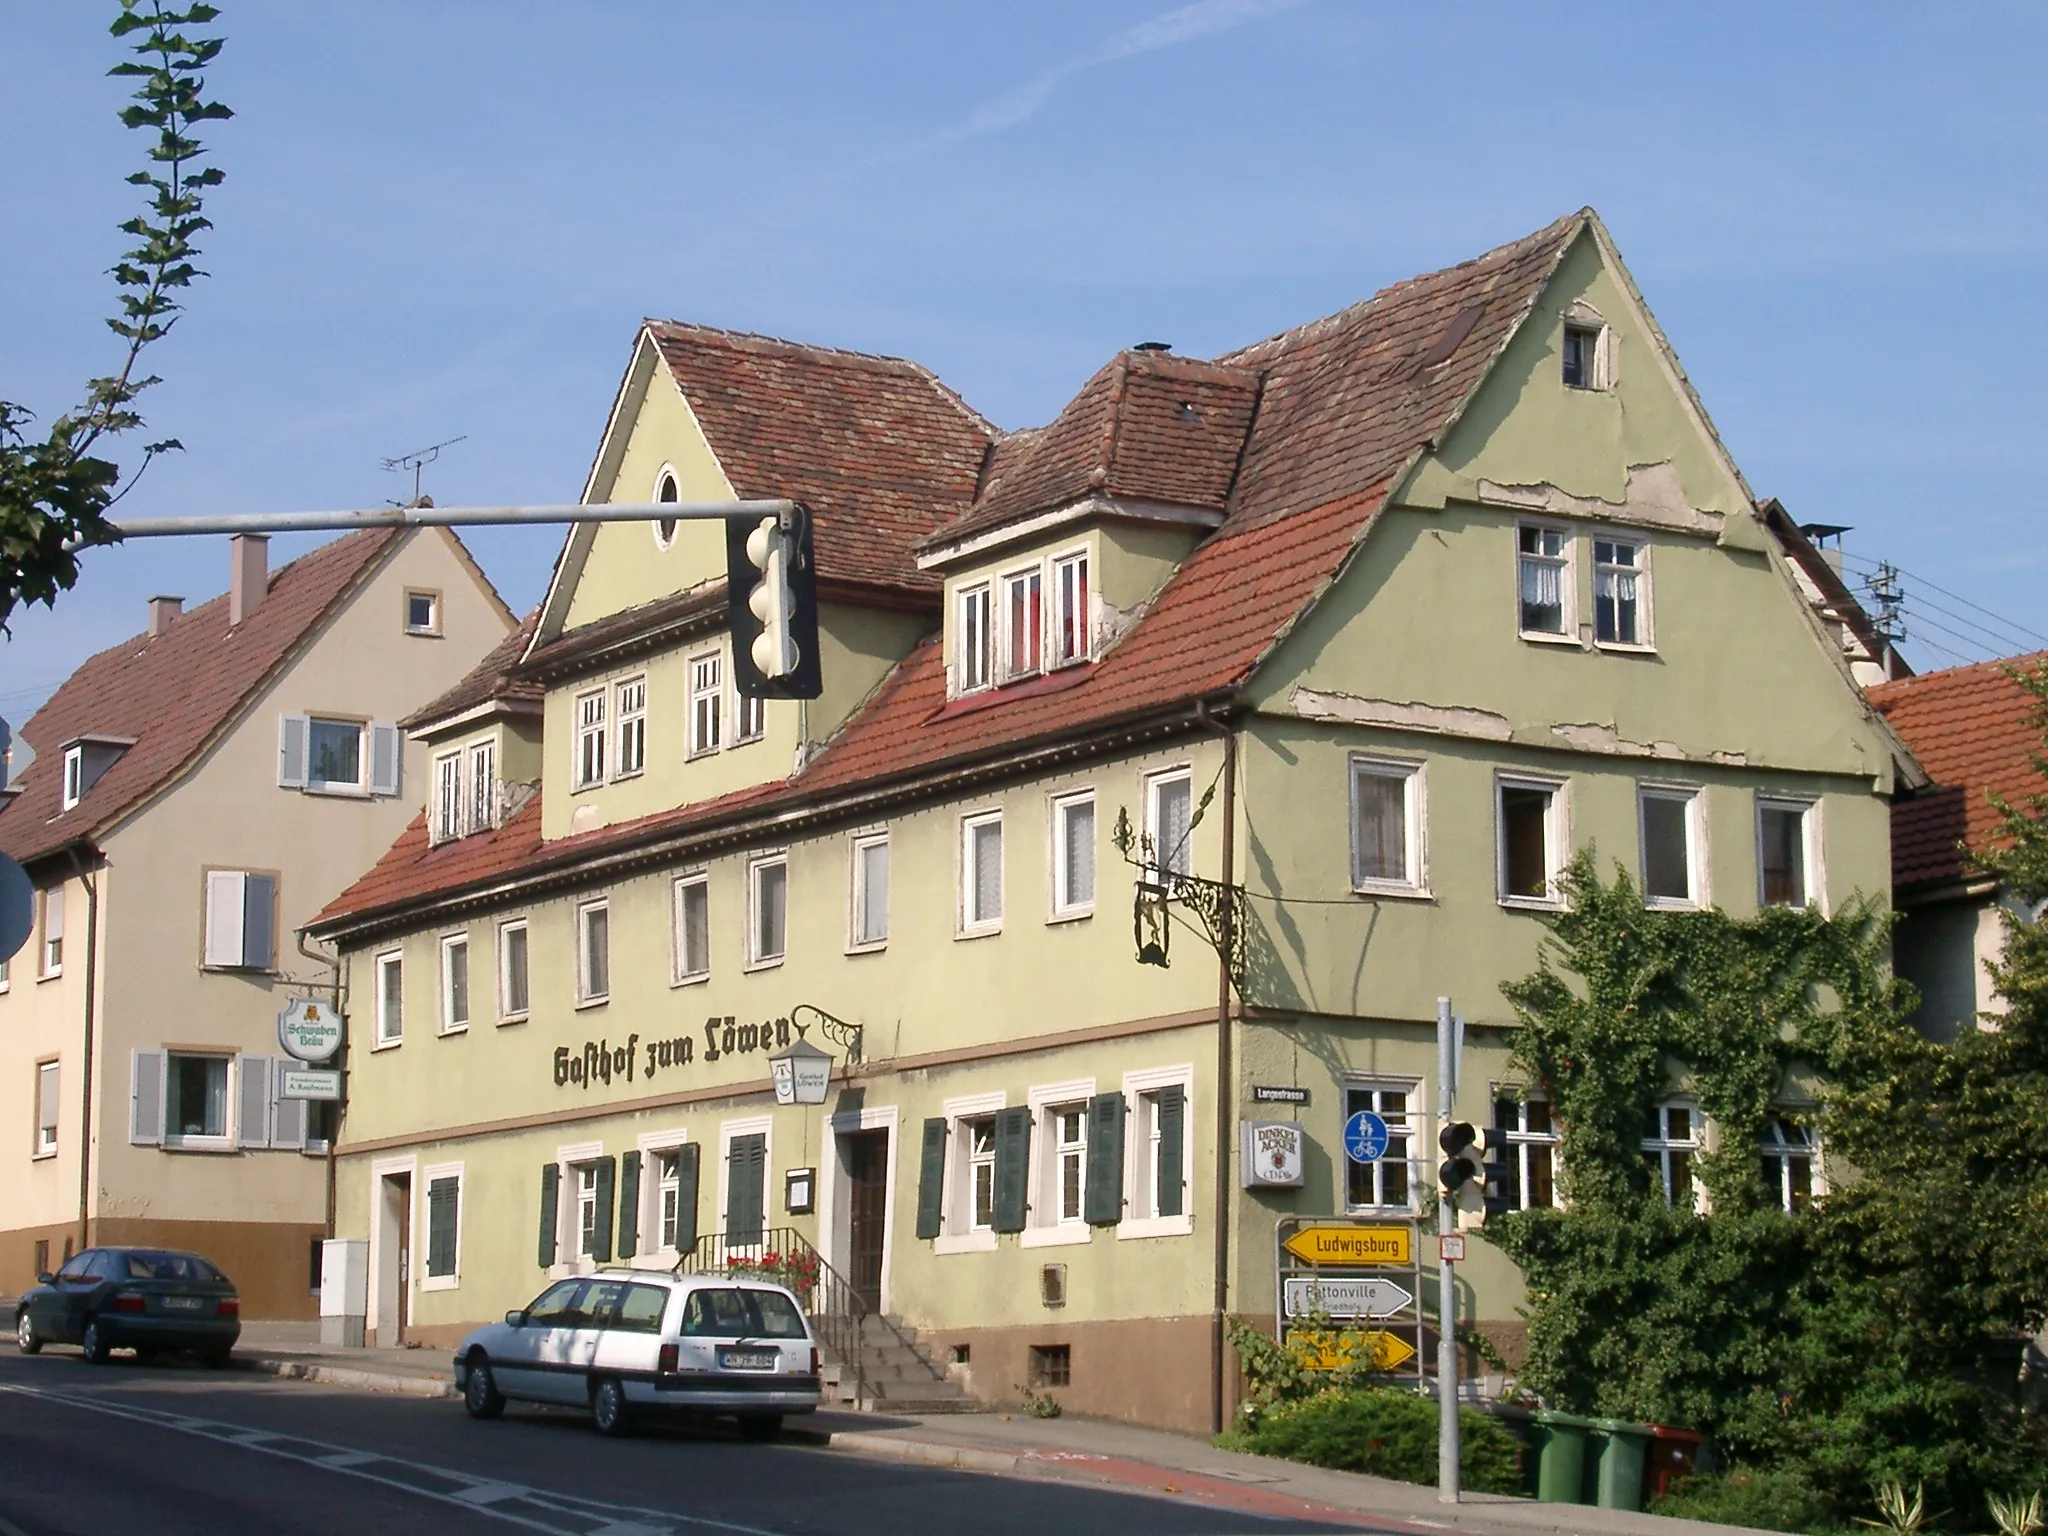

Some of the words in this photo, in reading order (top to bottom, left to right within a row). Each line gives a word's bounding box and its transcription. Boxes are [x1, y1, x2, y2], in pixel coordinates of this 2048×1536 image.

[287, 1023, 337, 1036] Schwaben
[300, 1035, 324, 1047] Bräu
[553, 1033, 638, 1089] Gasthof
[644, 1034, 694, 1079] zum
[704, 1016, 791, 1062] Löwen
[1258, 1127, 1298, 1143] DINKEL
[1261, 1139, 1296, 1155] ACKER
[1316, 1235, 1400, 1257] Ludwigsburg
